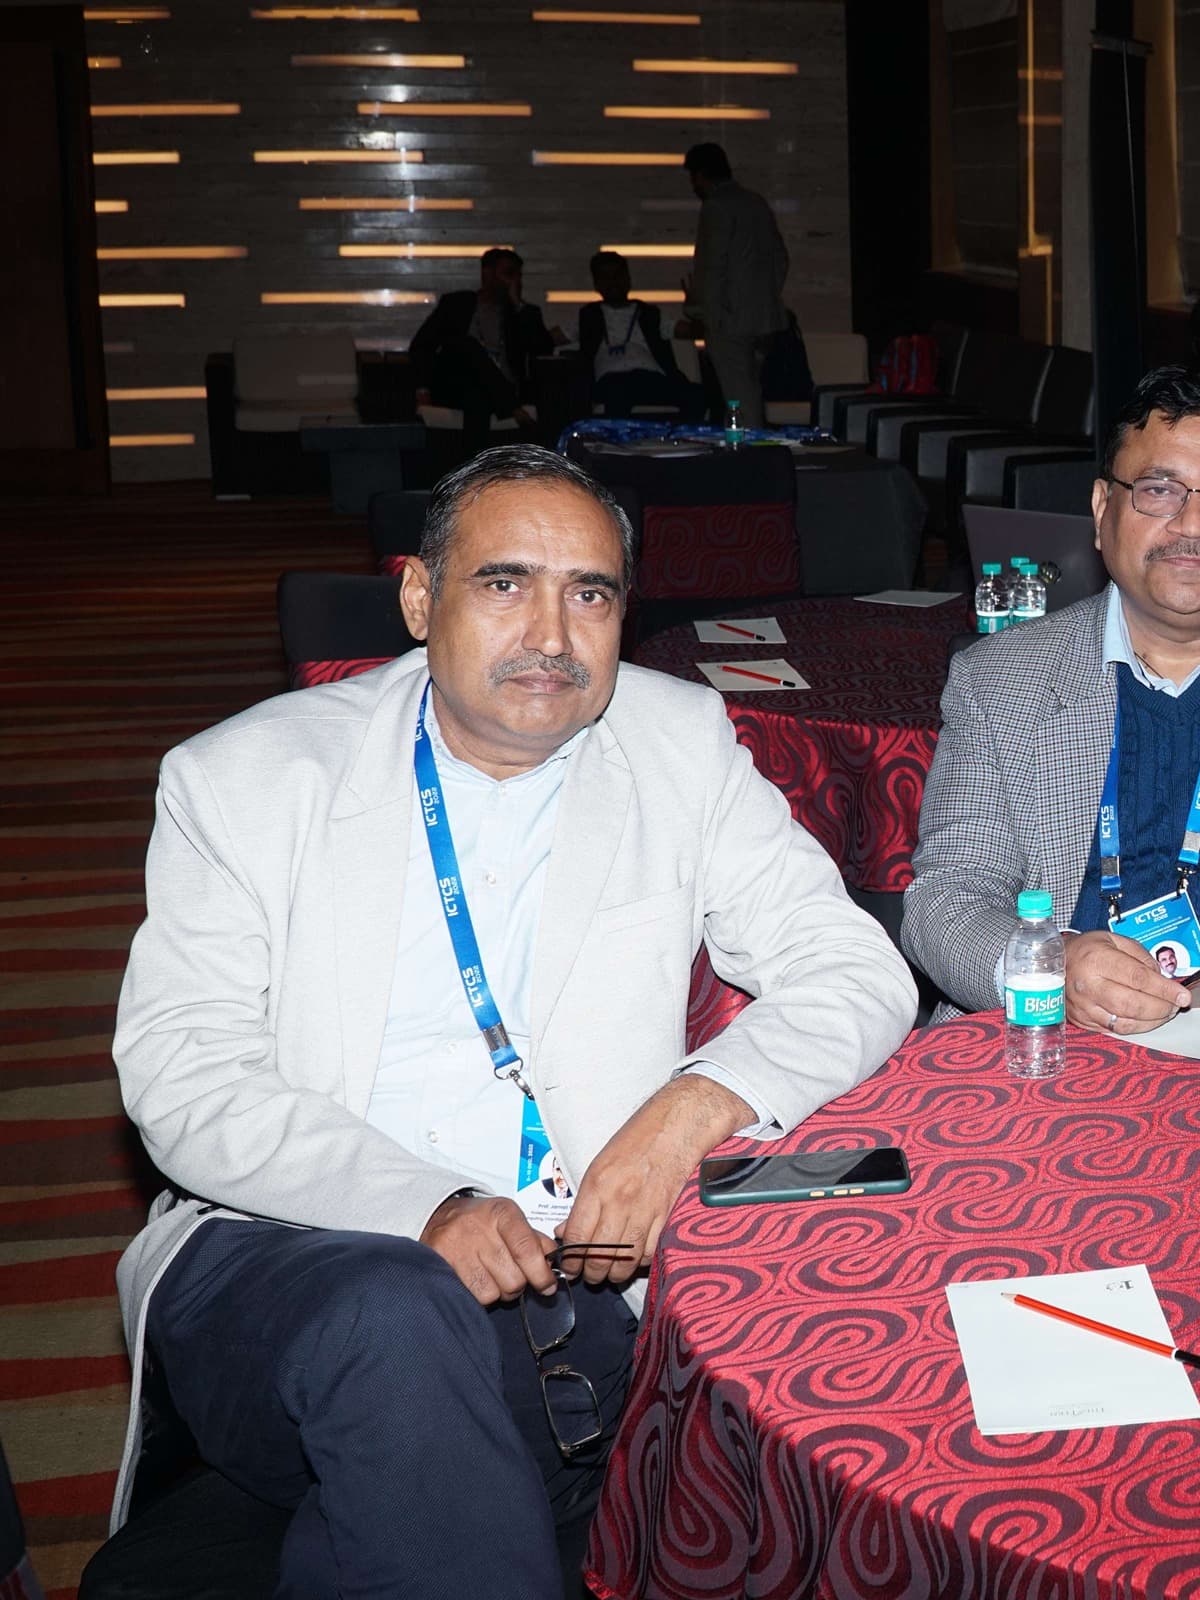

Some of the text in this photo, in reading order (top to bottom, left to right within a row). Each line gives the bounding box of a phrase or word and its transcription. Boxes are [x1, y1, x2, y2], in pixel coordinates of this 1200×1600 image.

[421, 788, 438, 827] ICTCS
[1101, 805, 1112, 839] ICTCS
[439, 877, 459, 917] ICTCS
[1134, 905, 1167, 925] ICTCS
[462, 967, 484, 1008] ICTCS
